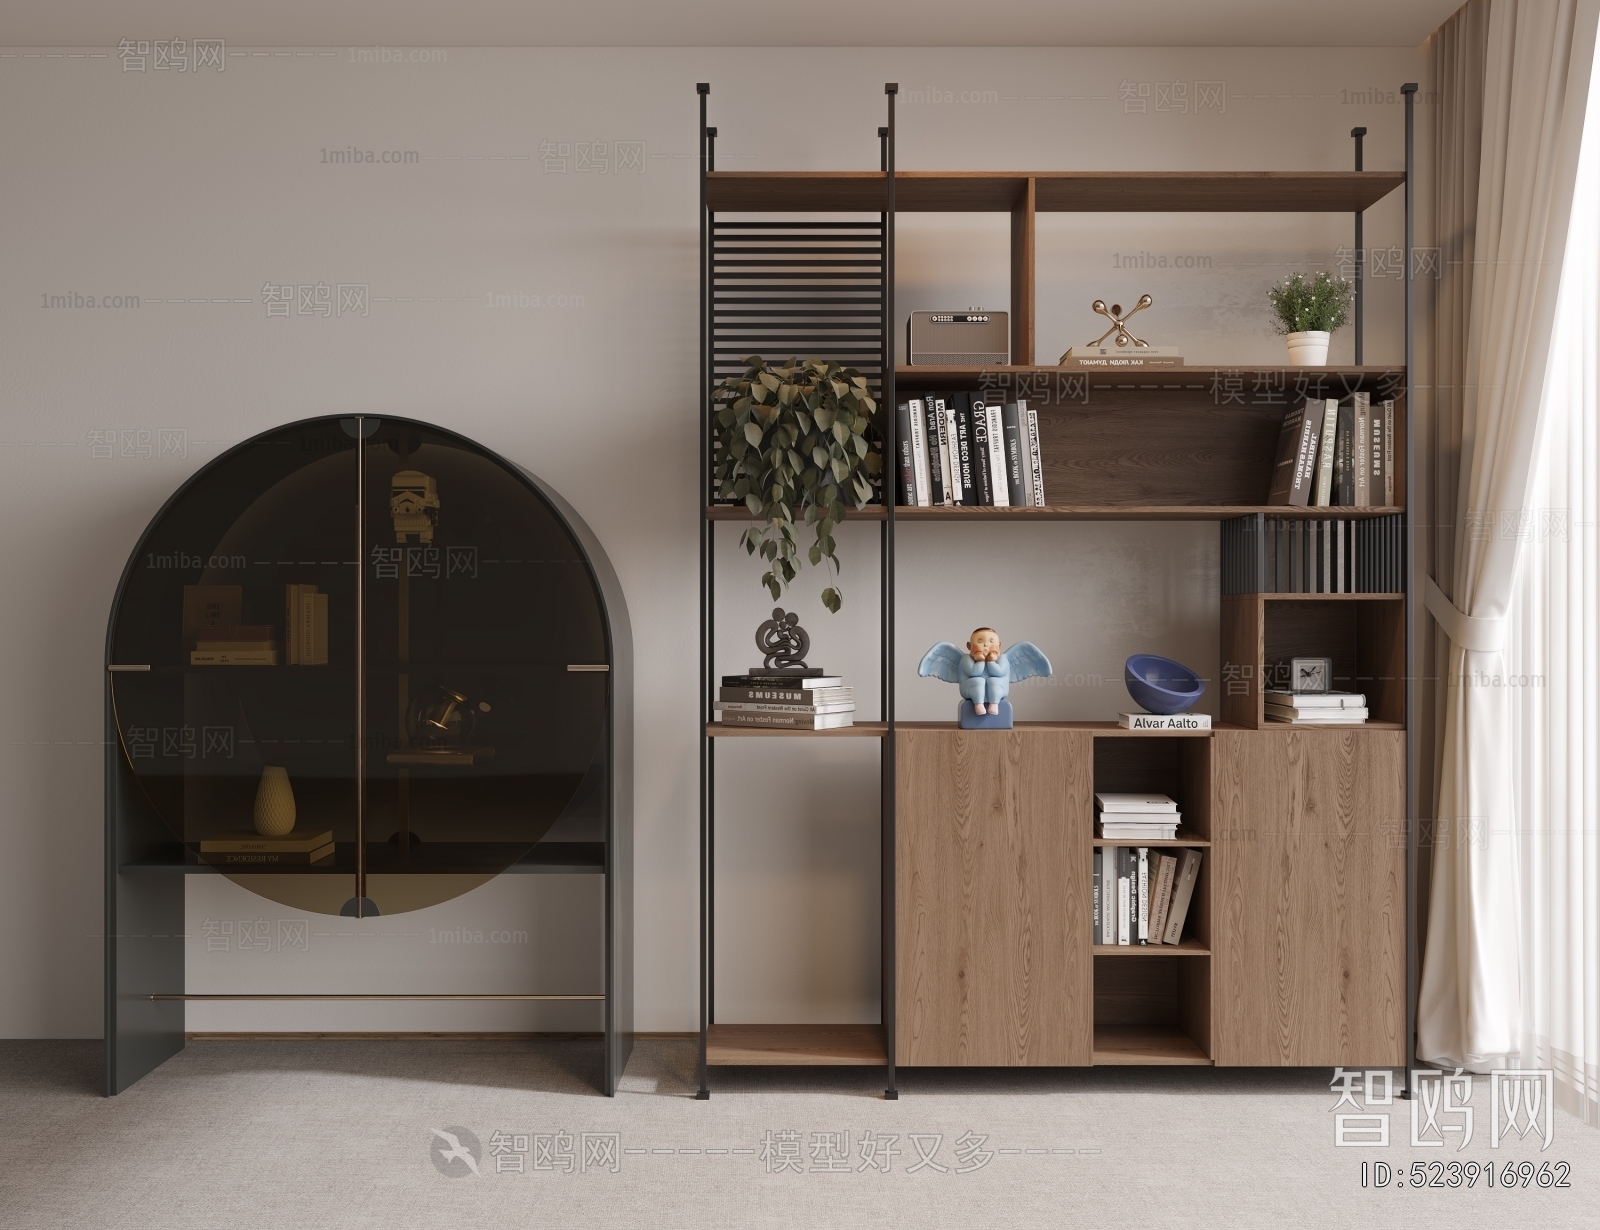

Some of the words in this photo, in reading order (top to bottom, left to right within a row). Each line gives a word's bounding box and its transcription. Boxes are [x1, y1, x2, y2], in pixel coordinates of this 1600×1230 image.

[1010, 439, 1018, 460] SYMBOLS
[1134, 718, 1165, 728] Alvar
[1167, 718, 1198, 728] Aalto
